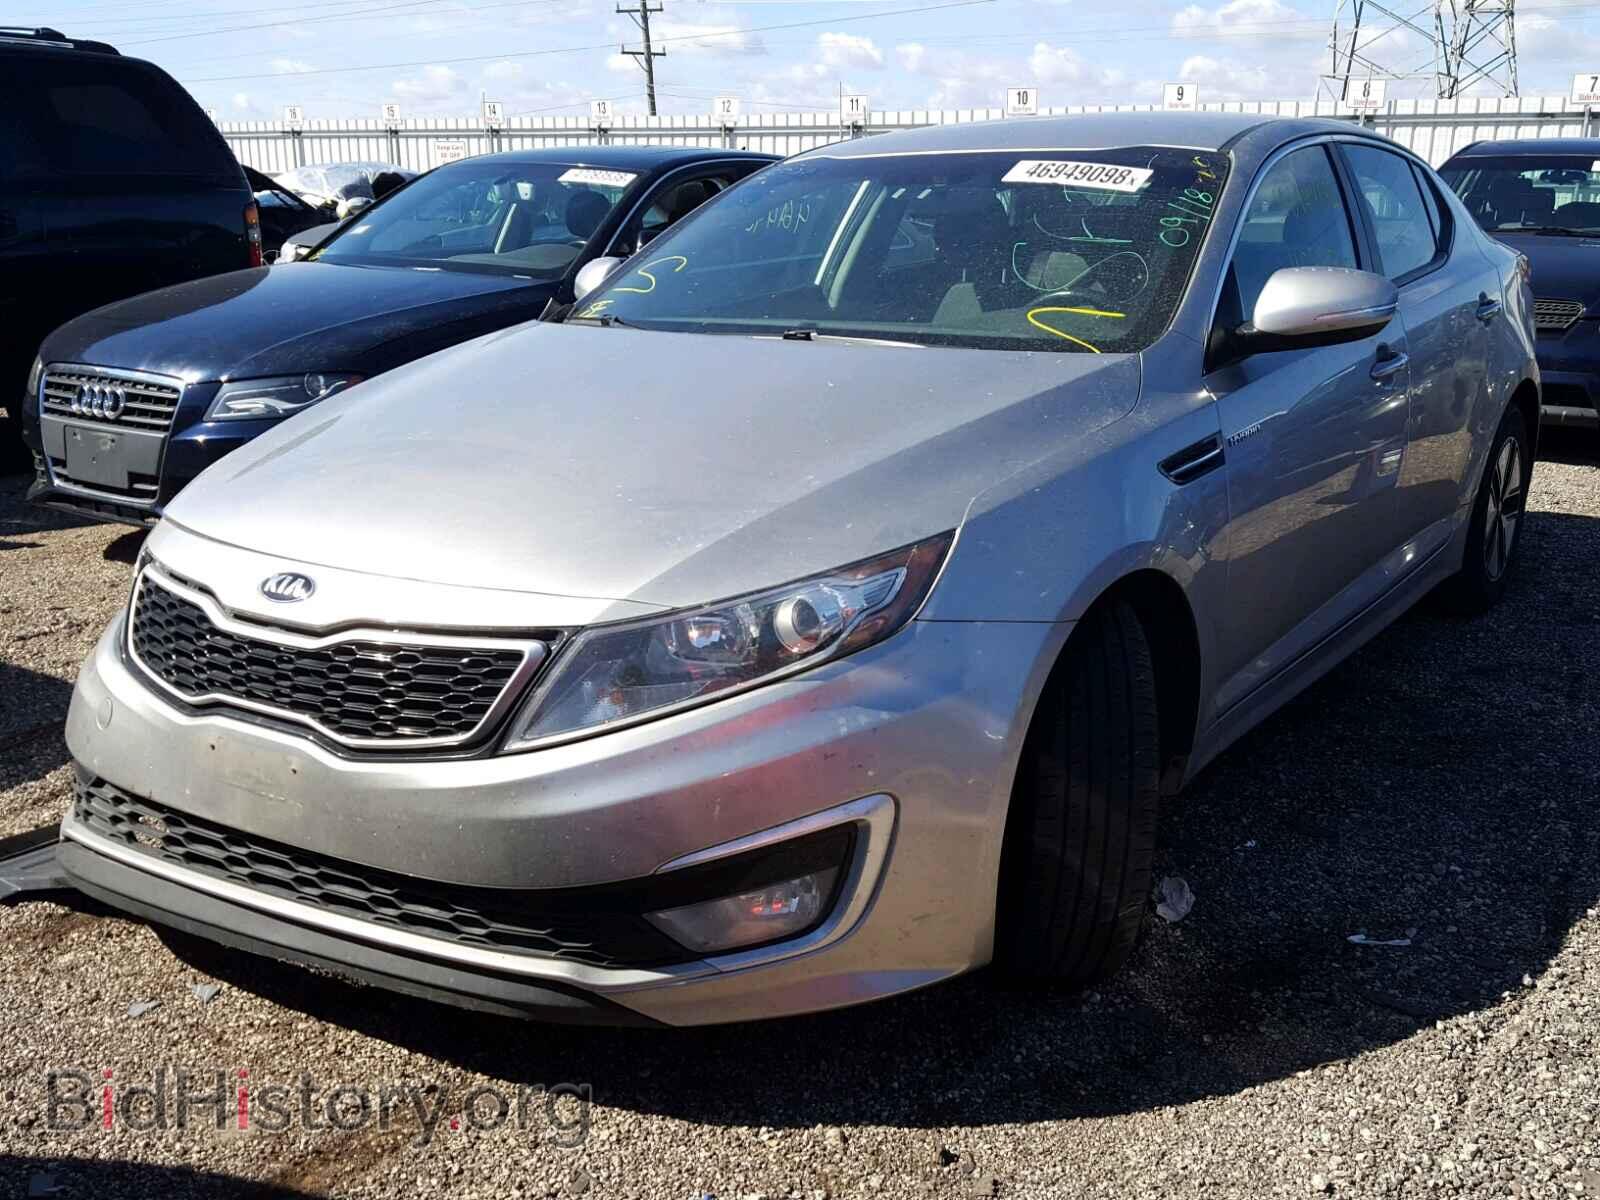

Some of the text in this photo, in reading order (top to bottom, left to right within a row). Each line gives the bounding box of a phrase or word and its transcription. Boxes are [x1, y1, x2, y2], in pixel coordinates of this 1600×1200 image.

[1362, 81, 1370, 98] 8
[1590, 75, 1598, 92] 7
[1016, 90, 1029, 105] 10
[1177, 86, 1184, 101] 9
[387, 105, 395, 118] 15
[488, 103, 496, 116] 14
[596, 101, 606, 114] 13
[722, 99, 731, 113] 12
[849, 97, 859, 112] 11
[262, 574, 307, 599] KIA
